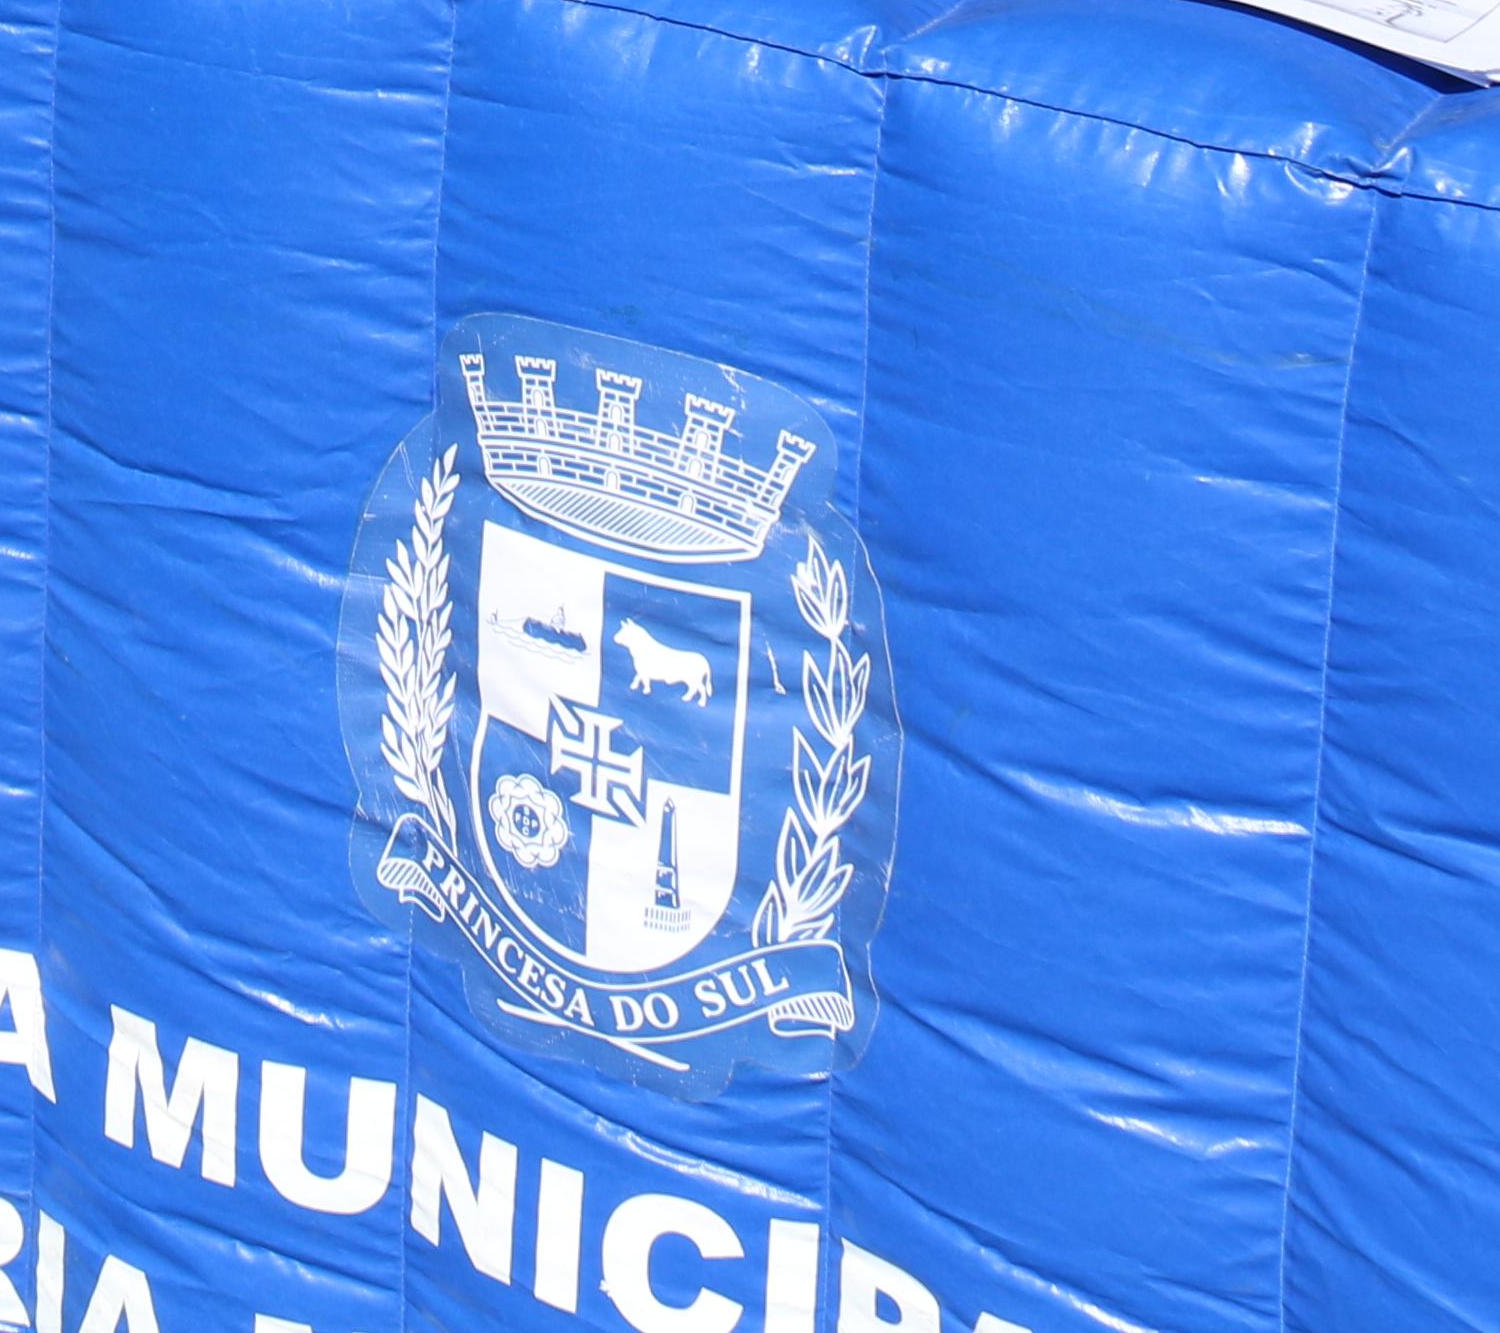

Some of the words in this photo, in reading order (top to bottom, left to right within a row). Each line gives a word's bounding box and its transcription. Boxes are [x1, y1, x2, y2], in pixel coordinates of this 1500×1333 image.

[422, 838, 595, 1027] PRINCESA
[609, 992, 680, 1032] DO
[694, 957, 790, 1018] SUL
[104, 1002, 1032, 1333] MUNICIP
